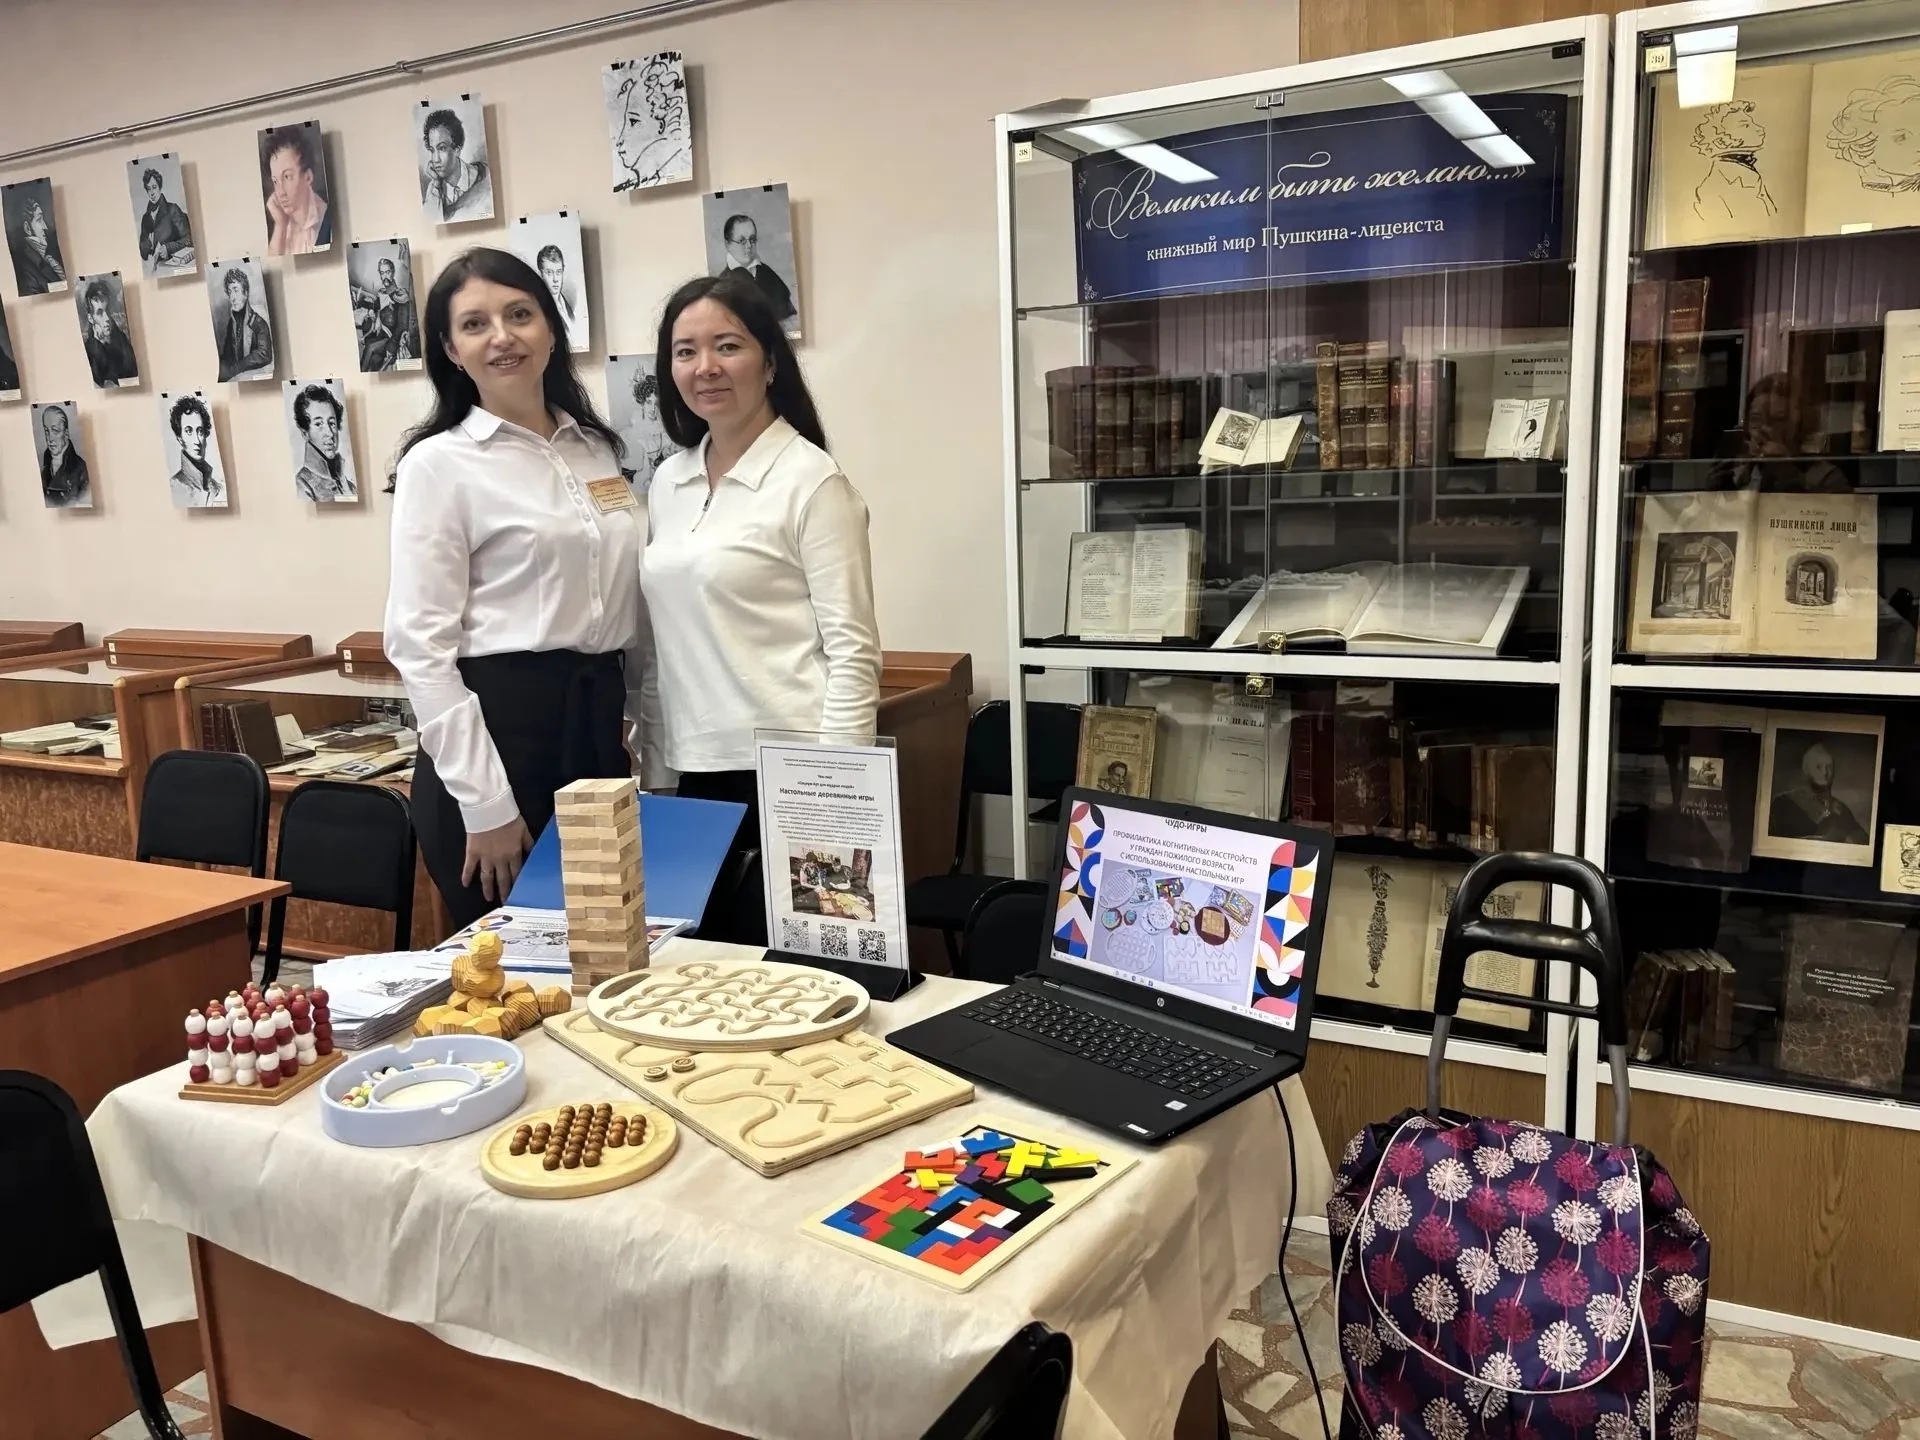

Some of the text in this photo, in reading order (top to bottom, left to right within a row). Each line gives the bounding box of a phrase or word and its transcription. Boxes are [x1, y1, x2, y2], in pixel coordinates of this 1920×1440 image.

[1269, 151, 1360, 201] быть
[1146, 217, 1445, 261] книжный мир Пушкина-лицеиста
[779, 787, 817, 798] Настольные
[817, 791, 858, 801] деревянные
[1165, 818, 1208, 833] ЧУДО-ИГРЫ
[1112, 830, 1258, 866] ПРОФИЛАКТИКА КОГНИТИВНЫХ РАССТРОЙСТВ
[1135, 845, 1163, 856] ГРАЖДАН
[1163, 851, 1201, 865] ПОЖИЛОГО
[1201, 858, 1235, 872] ВОЗРАСТА
[1119, 851, 1245, 885] С ИСПОЛЬЗОВАНИЕМ НАСТОЛЬНЫХ ИГР
